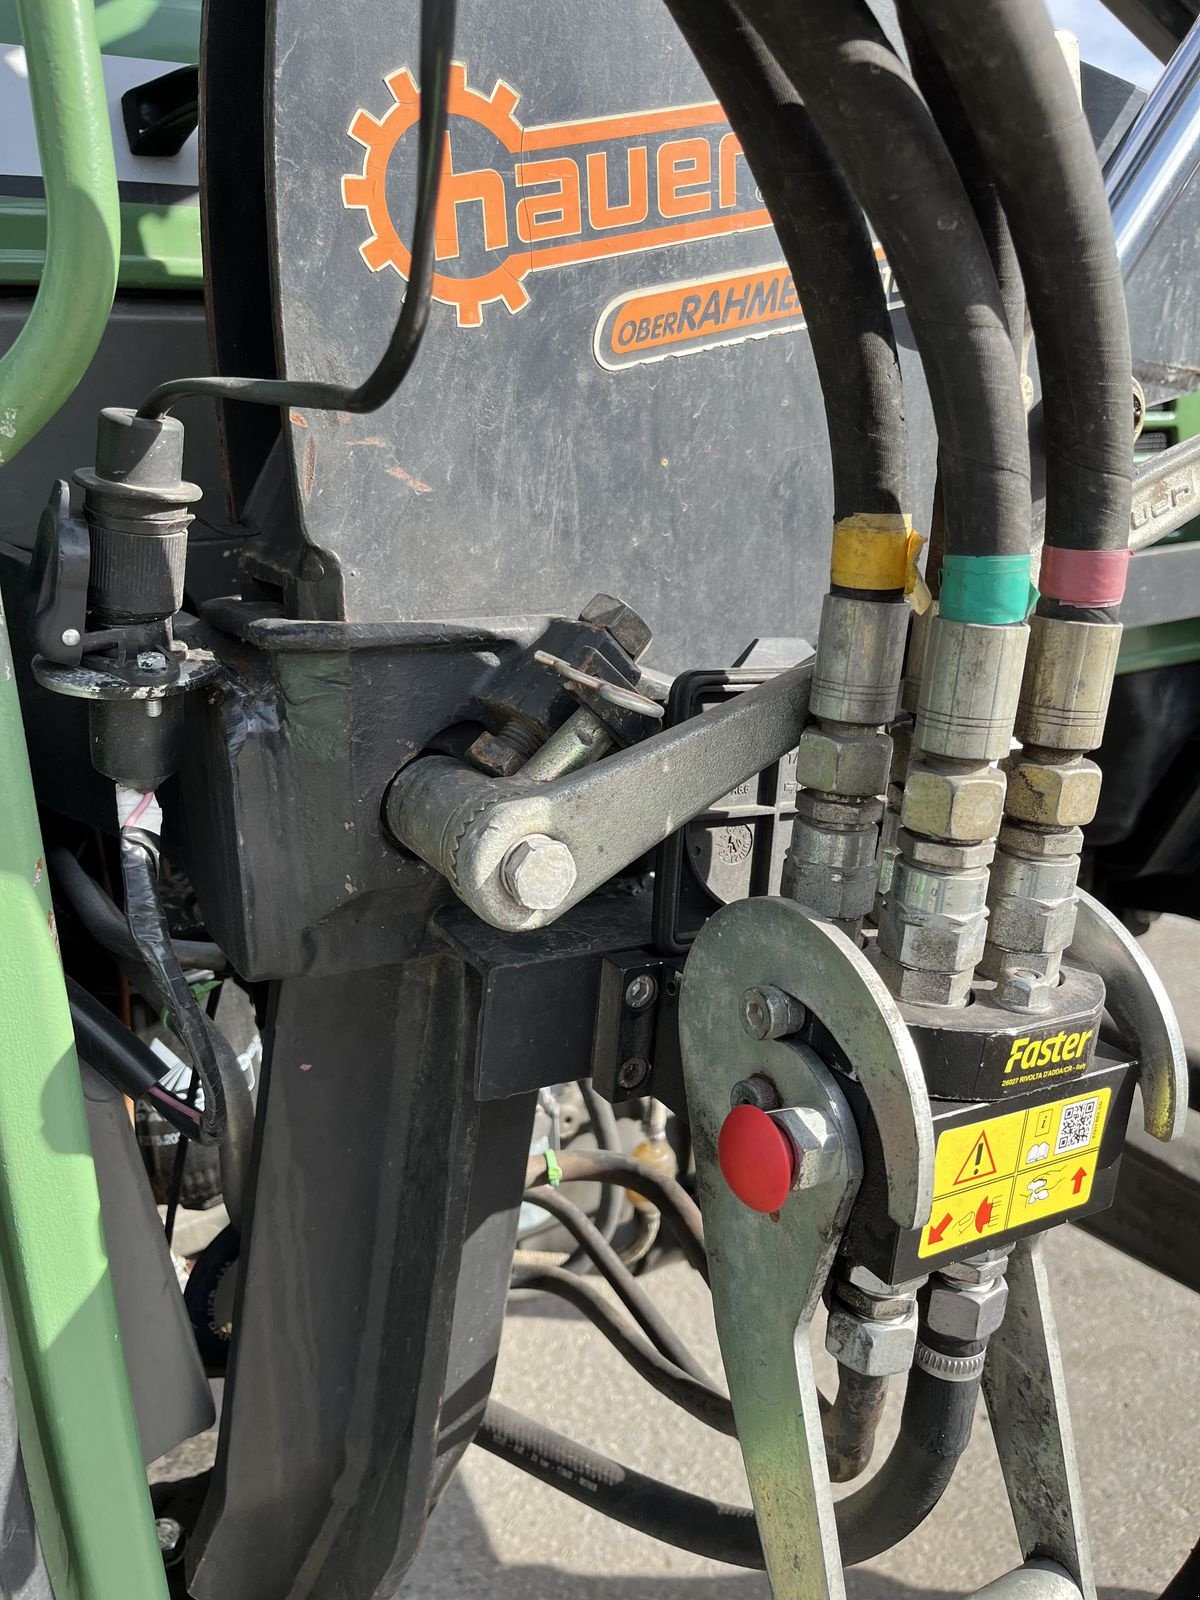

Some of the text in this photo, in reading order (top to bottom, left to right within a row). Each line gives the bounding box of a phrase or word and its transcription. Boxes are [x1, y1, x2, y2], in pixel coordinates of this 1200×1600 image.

[433, 130, 745, 261] hauer
[617, 275, 802, 347] OBERRAHME
[1003, 1030, 1093, 1073] Faster
[1019, 1072, 1042, 1083] RIVOLTA
